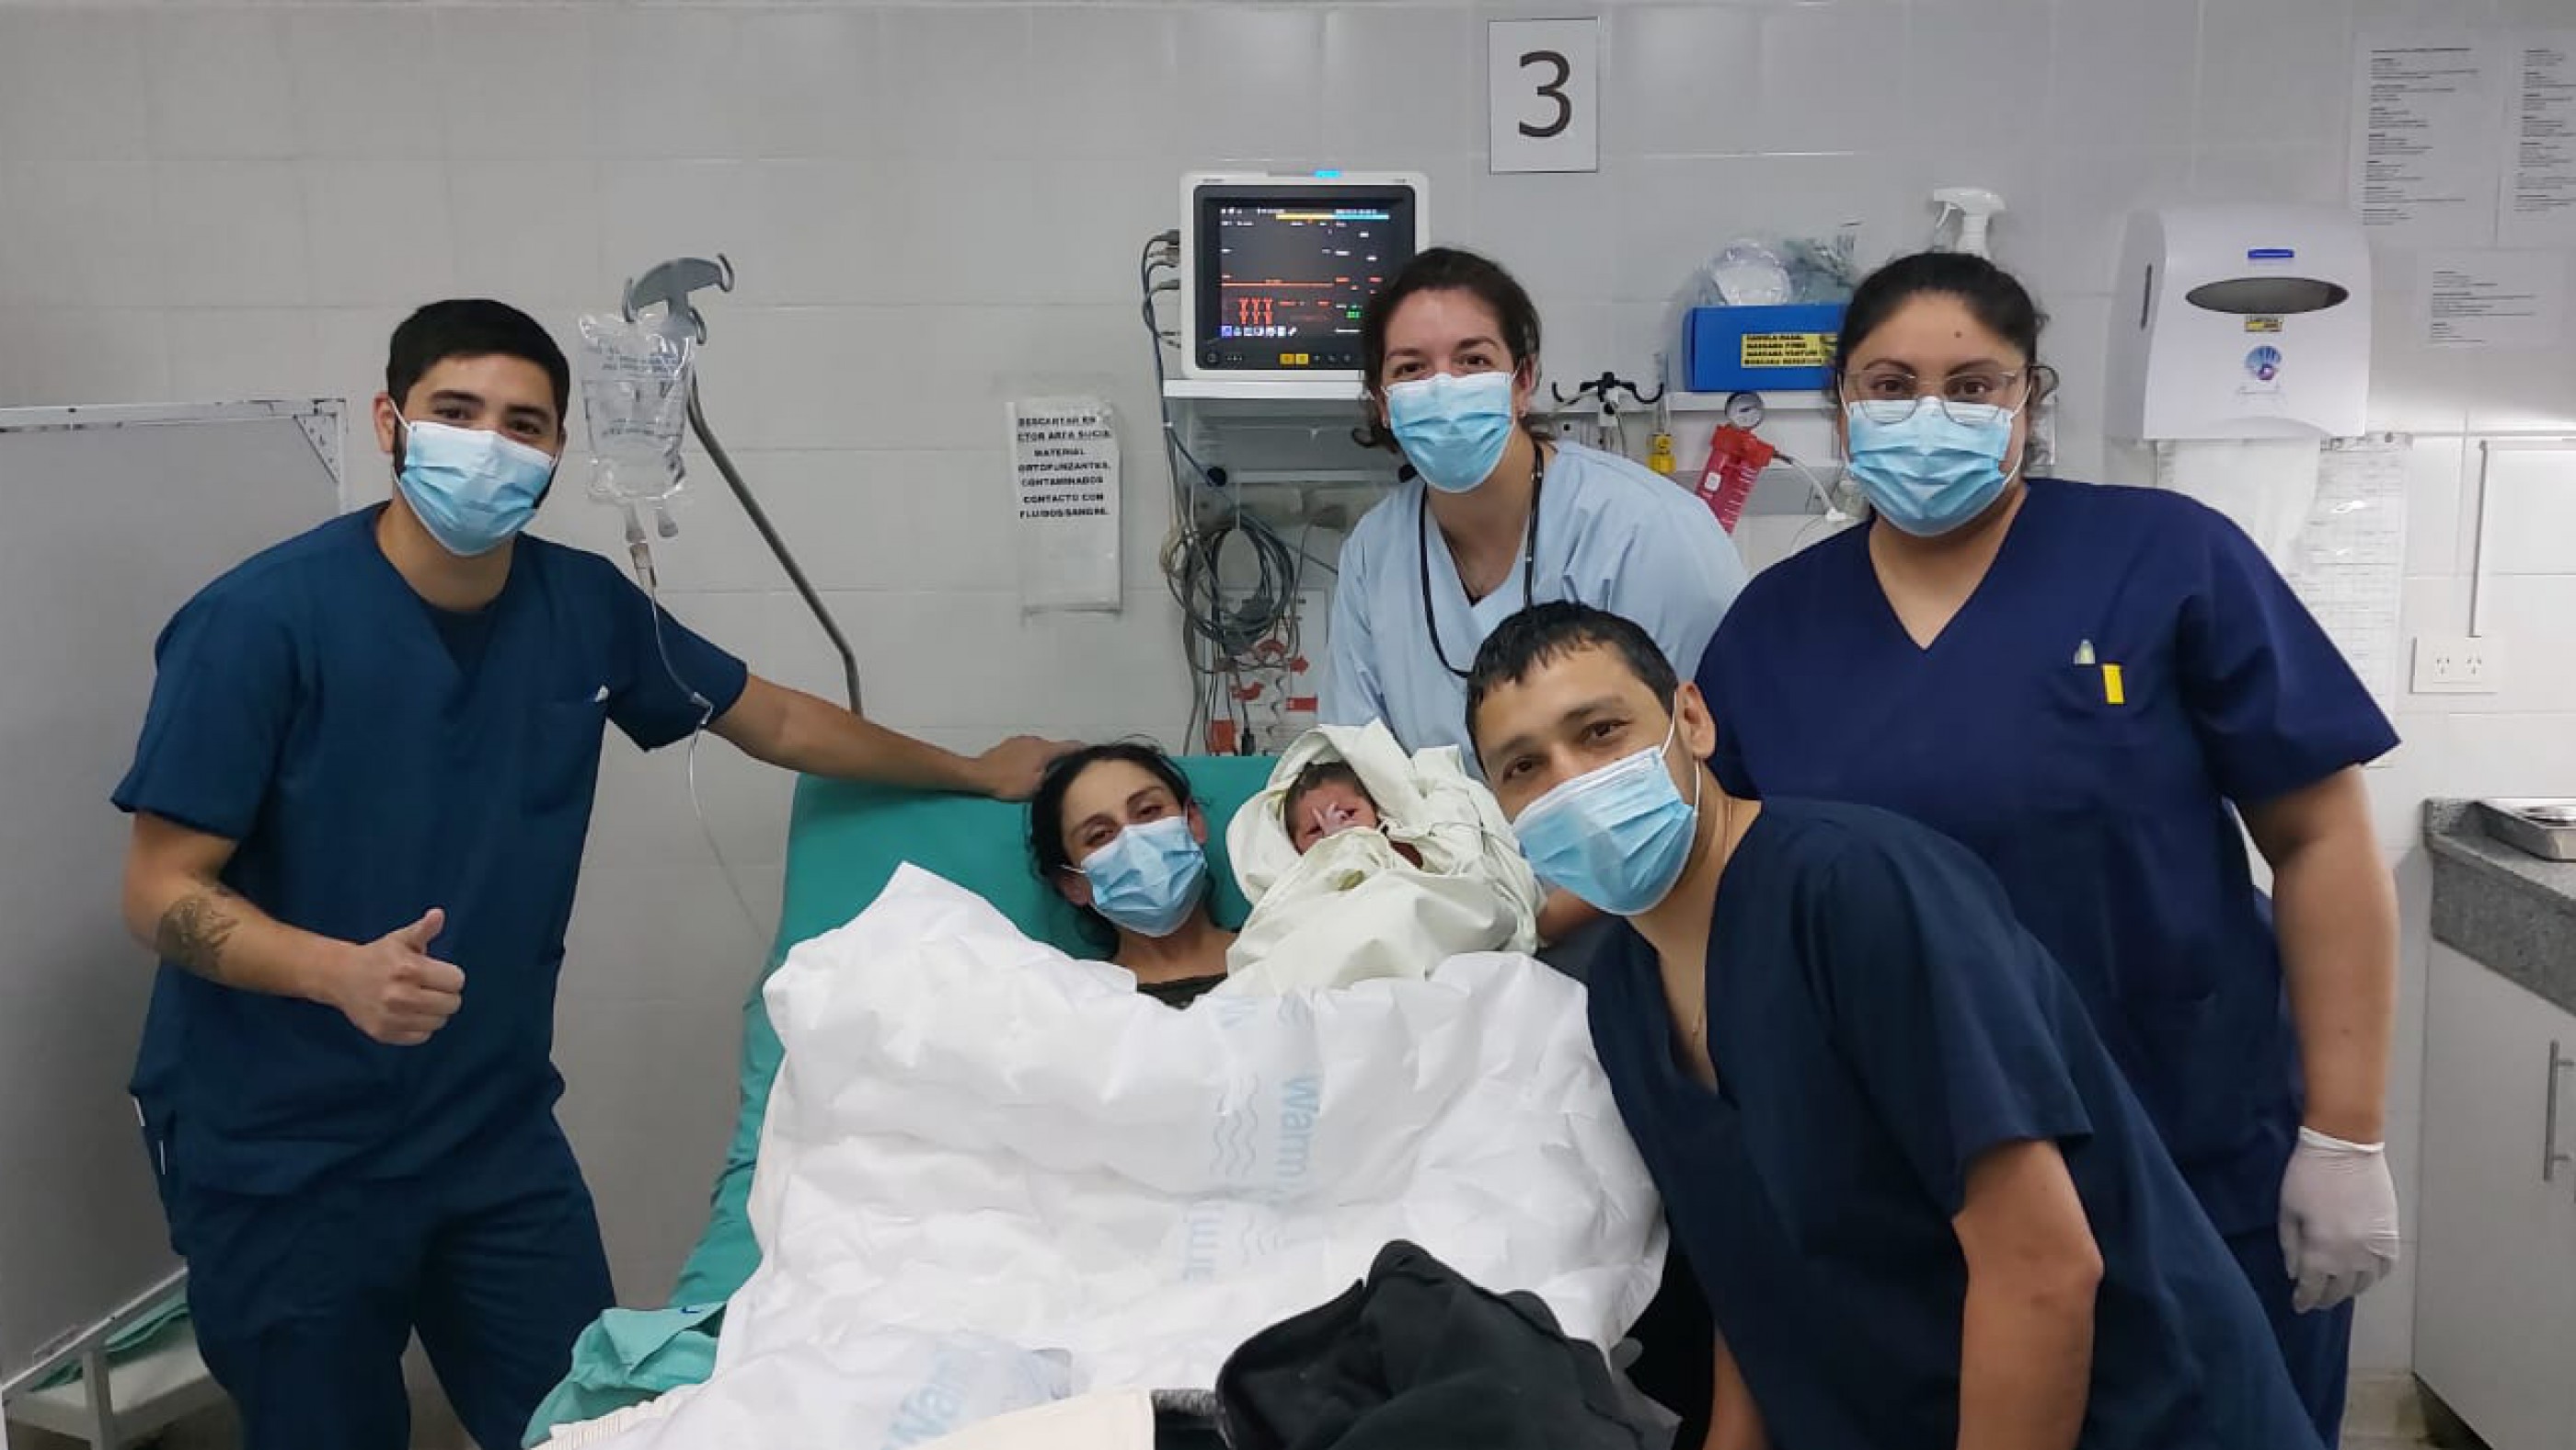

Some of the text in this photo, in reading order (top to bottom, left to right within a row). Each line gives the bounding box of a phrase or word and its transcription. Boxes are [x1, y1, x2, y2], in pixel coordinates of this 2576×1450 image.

[1519, 50, 1572, 138] 3
[1018, 418, 1079, 426] DESCARTAR
[1034, 449, 1086, 457] MATERIAL
[1022, 477, 1104, 487] CONTAMINADOS
[1024, 493, 1104, 503] CONTACTO CON
[1277, 1076, 1321, 1178] Warm
